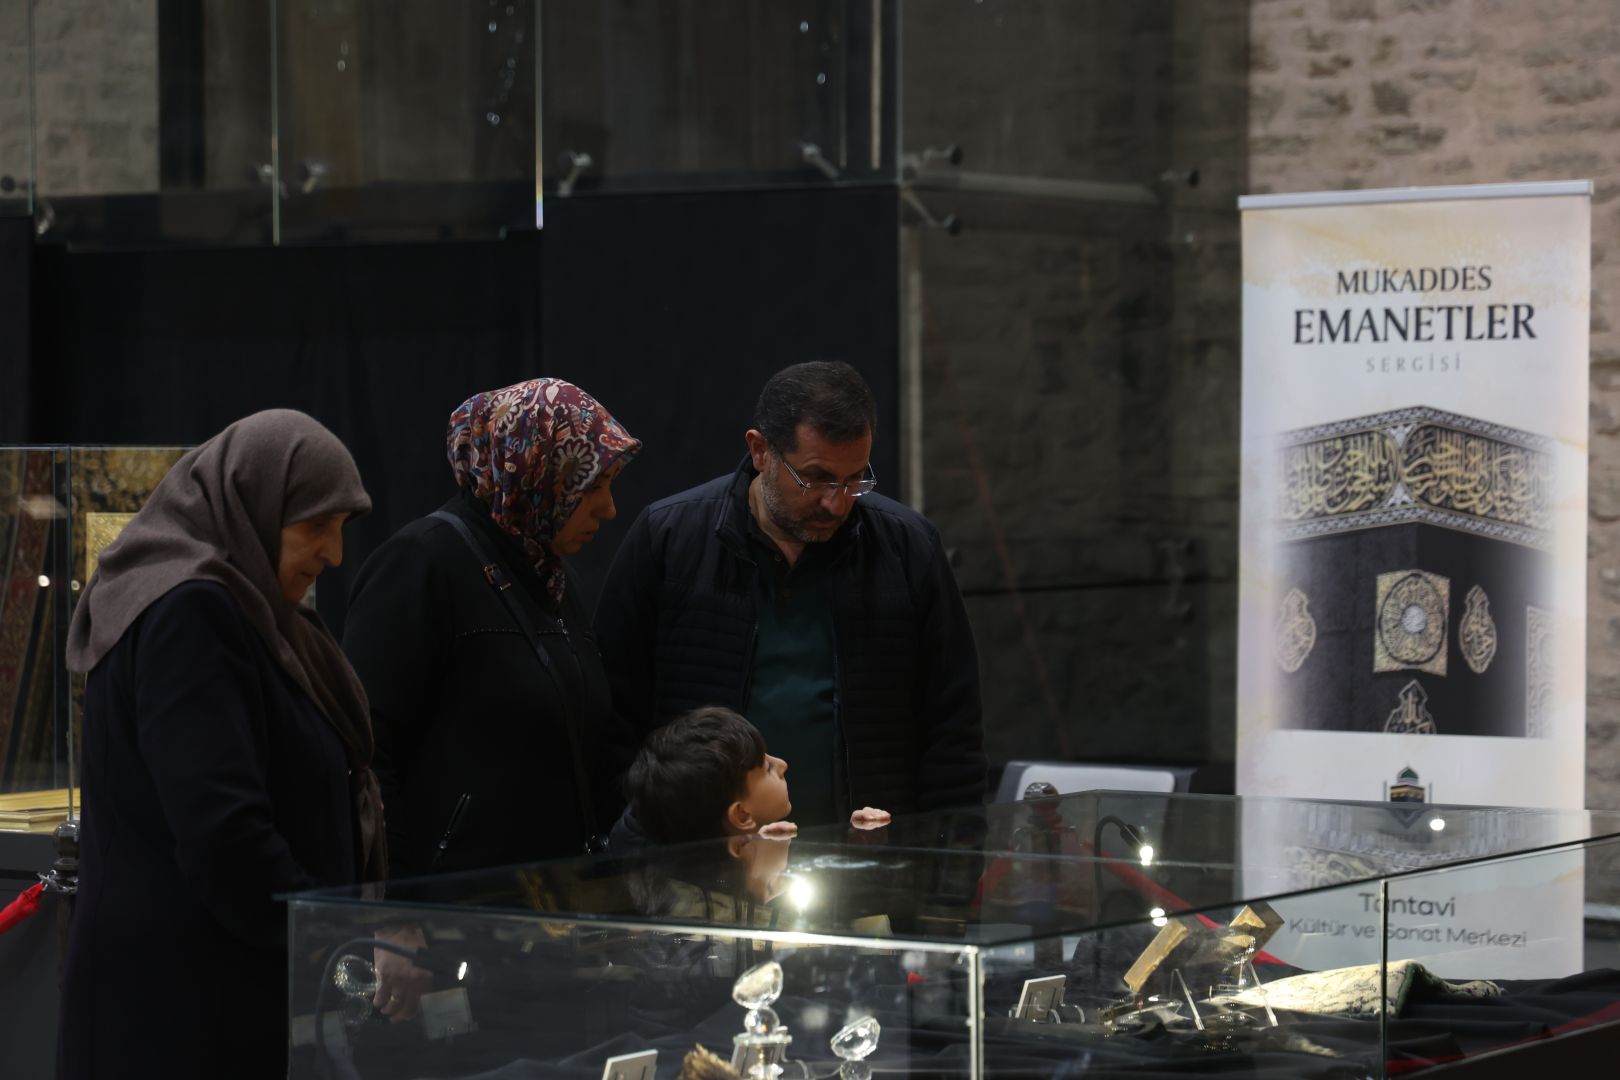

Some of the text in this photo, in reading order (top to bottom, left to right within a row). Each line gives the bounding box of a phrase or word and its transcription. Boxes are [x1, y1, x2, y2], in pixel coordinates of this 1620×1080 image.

[1337, 266, 1492, 294] MUKADDES
[1294, 304, 1537, 344] EMANETLER
[1366, 353, 1461, 373] SERGİSİ
[1358, 892, 1456, 917] Tantavi
[1351, 925, 1376, 938] ve
[1386, 924, 1442, 943] Sanat
[1446, 928, 1528, 947] Merkezi
